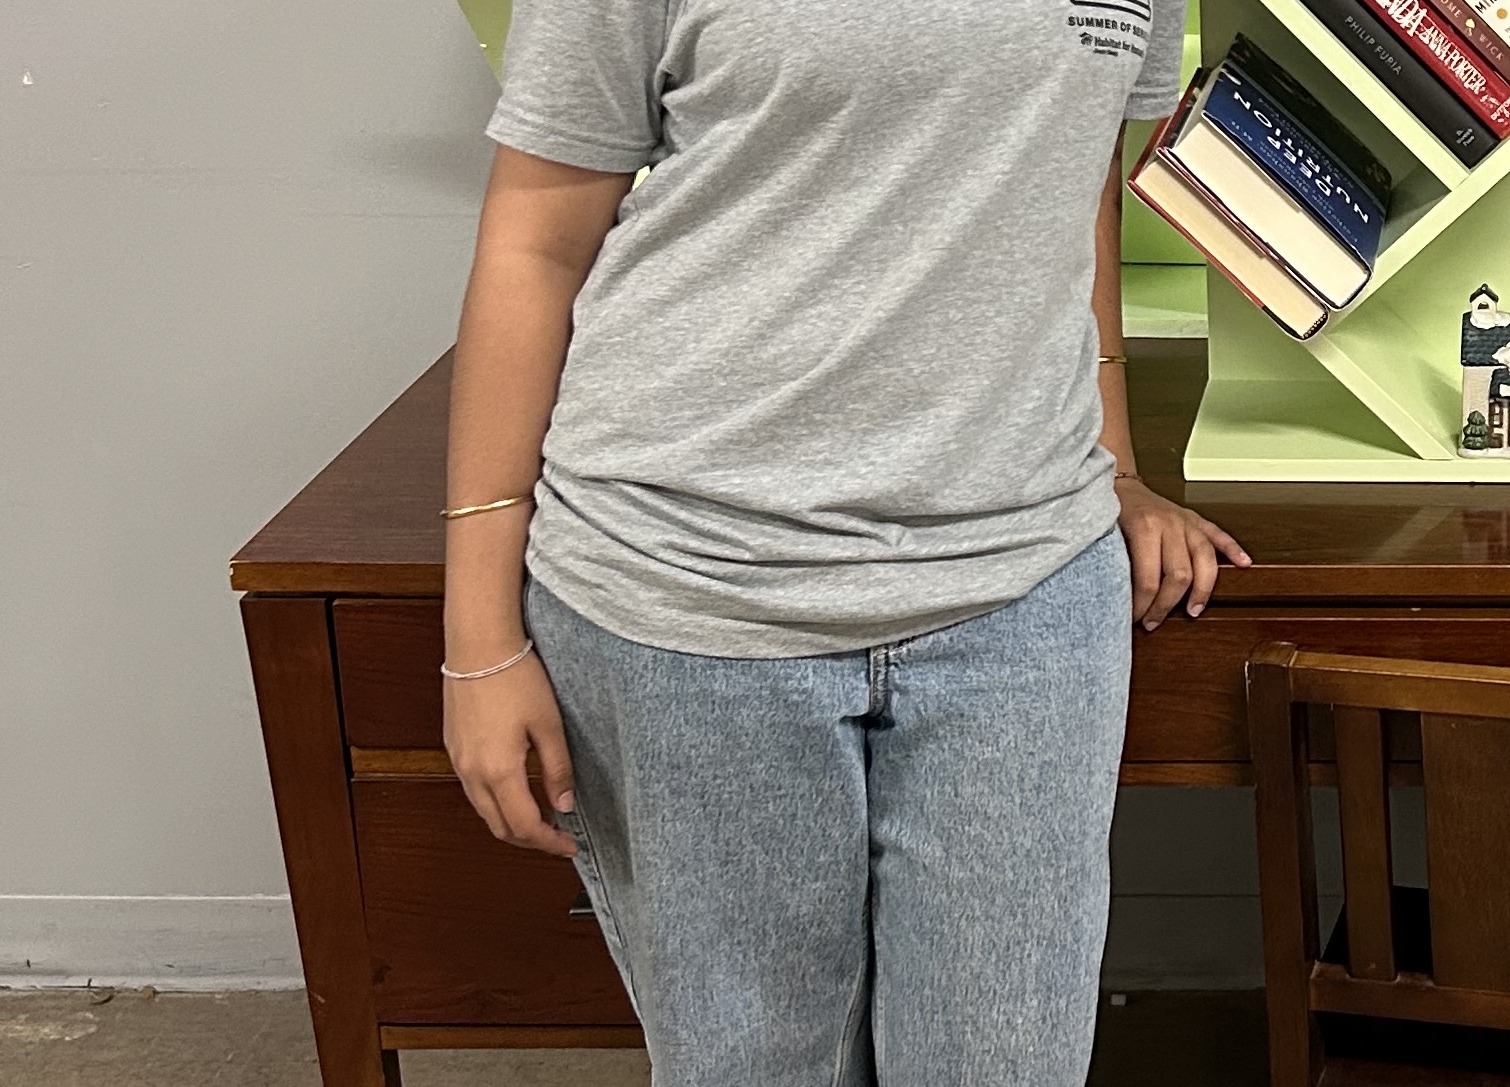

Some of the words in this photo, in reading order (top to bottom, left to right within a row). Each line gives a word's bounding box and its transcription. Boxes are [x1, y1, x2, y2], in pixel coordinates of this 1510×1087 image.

[1068, 16, 1118, 30] SUMMER
[1120, 21, 1131, 33] OF
[1345, 15, 1375, 46] PHILIP
[1374, 44, 1402, 76] FURIA
[1479, 33, 1505, 61] WICK
[1418, 26, 1452, 65] ANNA
[1447, 49, 1487, 95] PORTER
[1233, 91, 1369, 224] NUTRITION
[1267, 135, 1331, 197] DEEP
